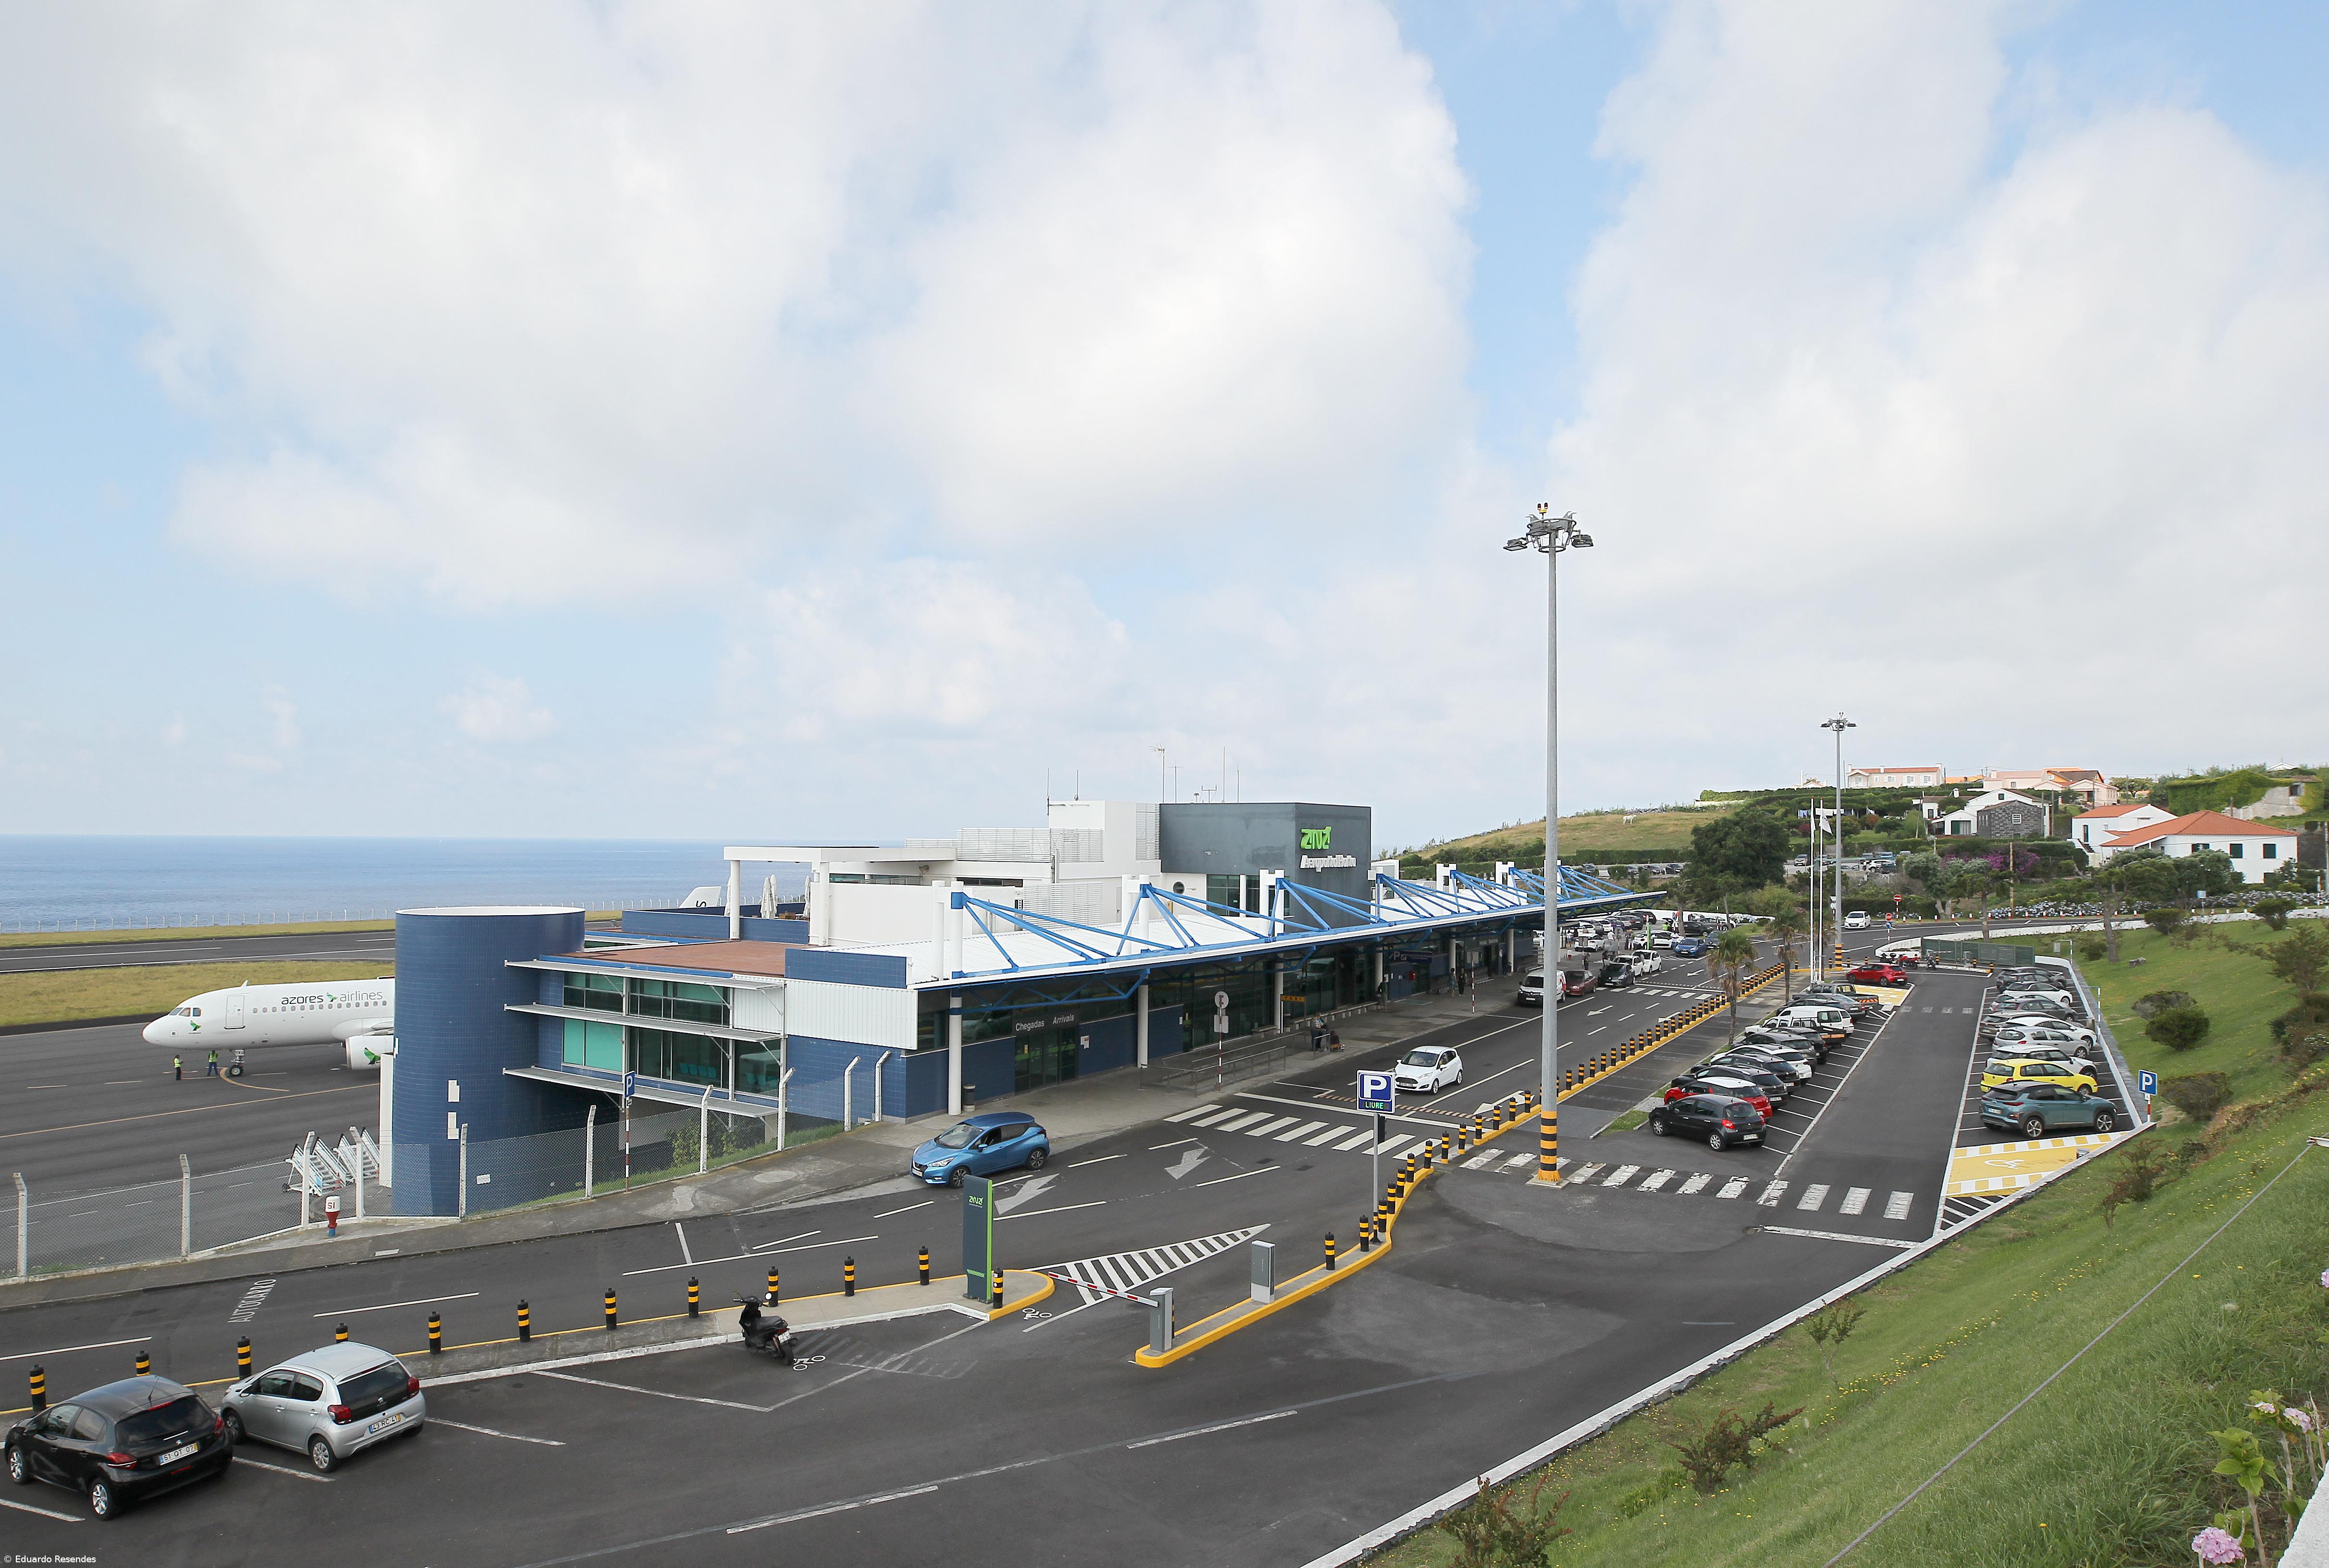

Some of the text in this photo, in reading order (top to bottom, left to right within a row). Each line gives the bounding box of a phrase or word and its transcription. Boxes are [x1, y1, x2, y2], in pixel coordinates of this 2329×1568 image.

[282, 991, 383, 1005] azores airlines
[1016, 1014, 1075, 1031] Chegadas Arrivals
[626, 1075, 633, 1095] P
[1363, 1075, 1387, 1098] P
[2142, 1073, 2153, 1091] P
[227, 1279, 277, 1323] AUTOCARRO
